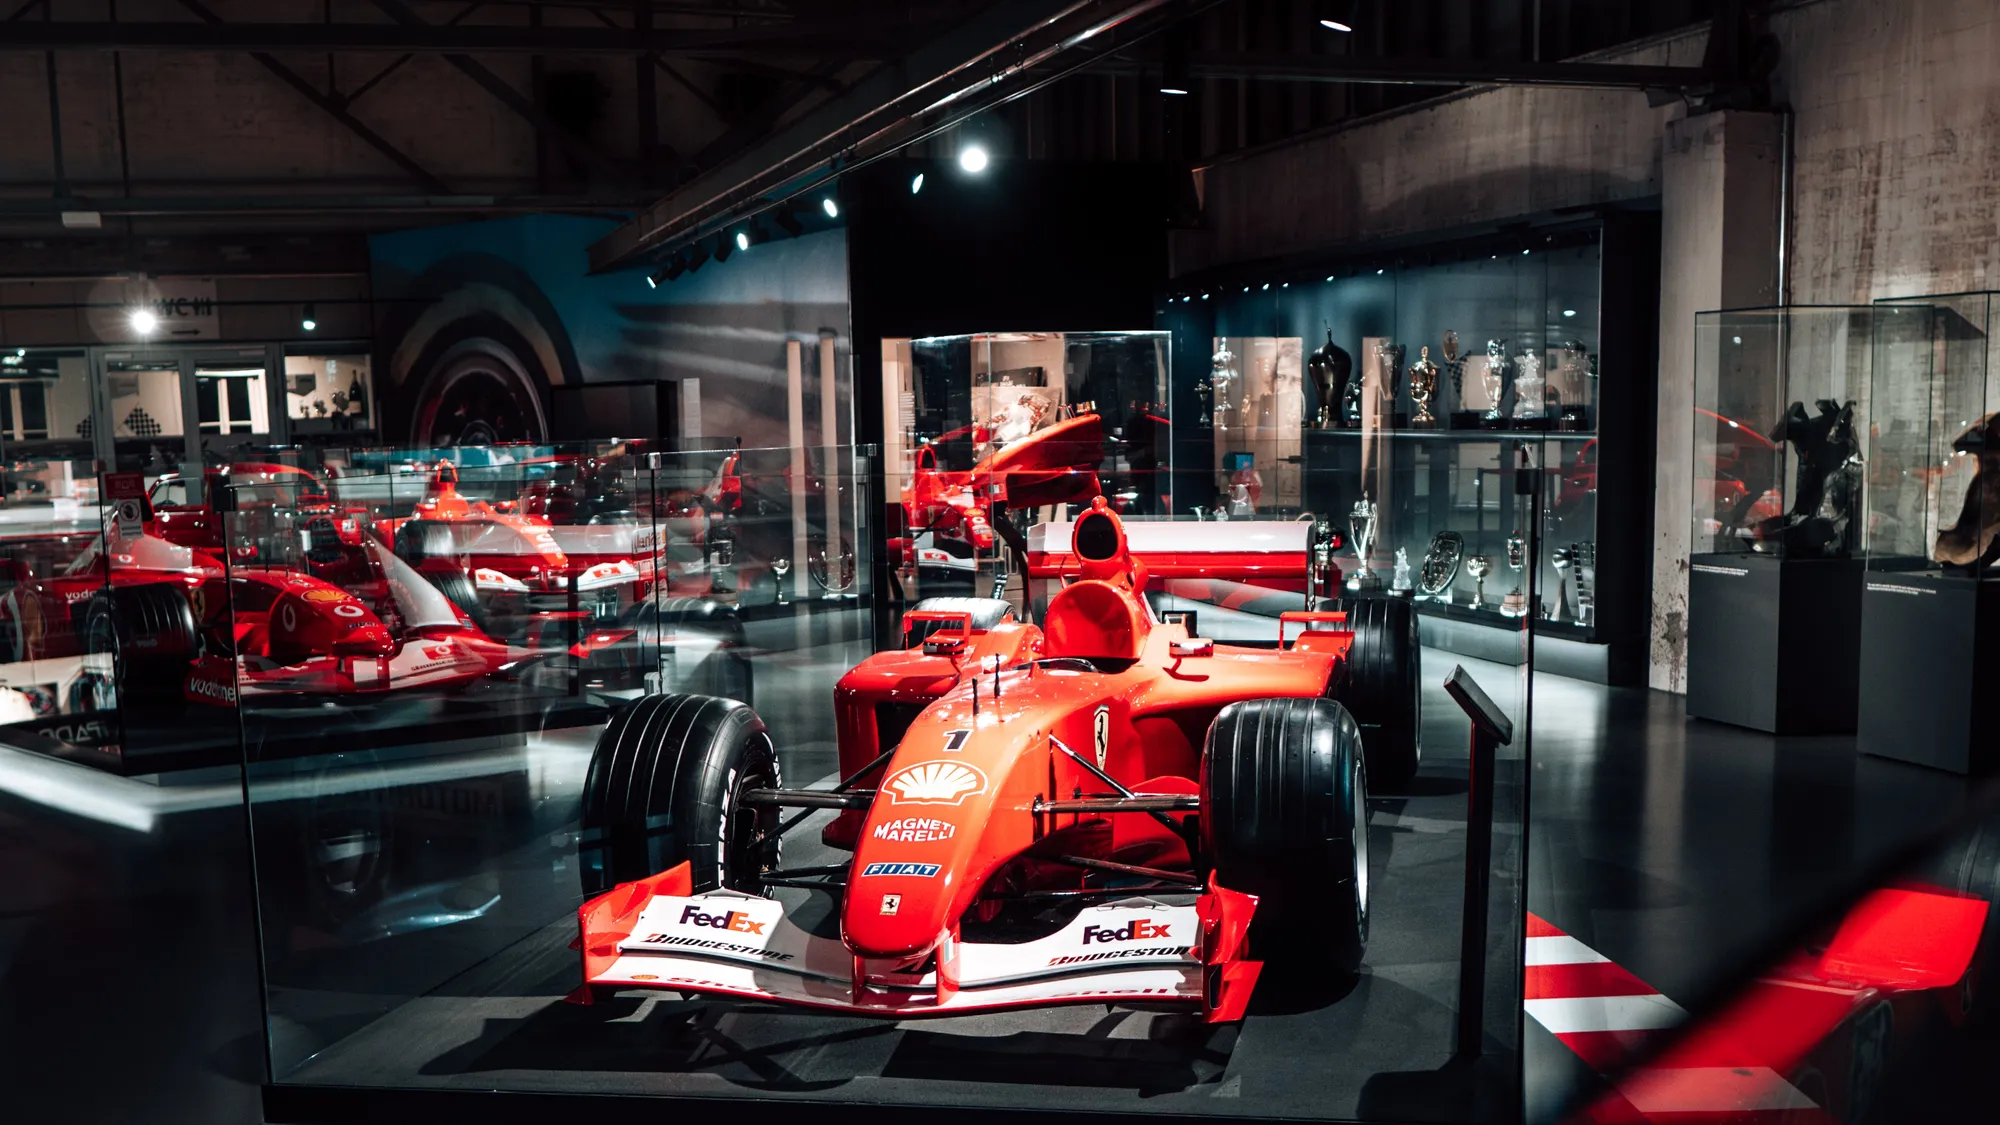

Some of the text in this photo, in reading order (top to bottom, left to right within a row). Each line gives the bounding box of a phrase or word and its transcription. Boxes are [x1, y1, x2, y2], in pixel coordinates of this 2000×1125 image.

[942, 728, 974, 752] 1
[873, 817, 956, 838] MAGNETI
[873, 824, 956, 842] MARELLI
[867, 863, 937, 876] FIAT
[679, 904, 766, 936] FedEx
[1082, 918, 1172, 946] FedEx
[640, 933, 795, 962] BRIDGESTONE
